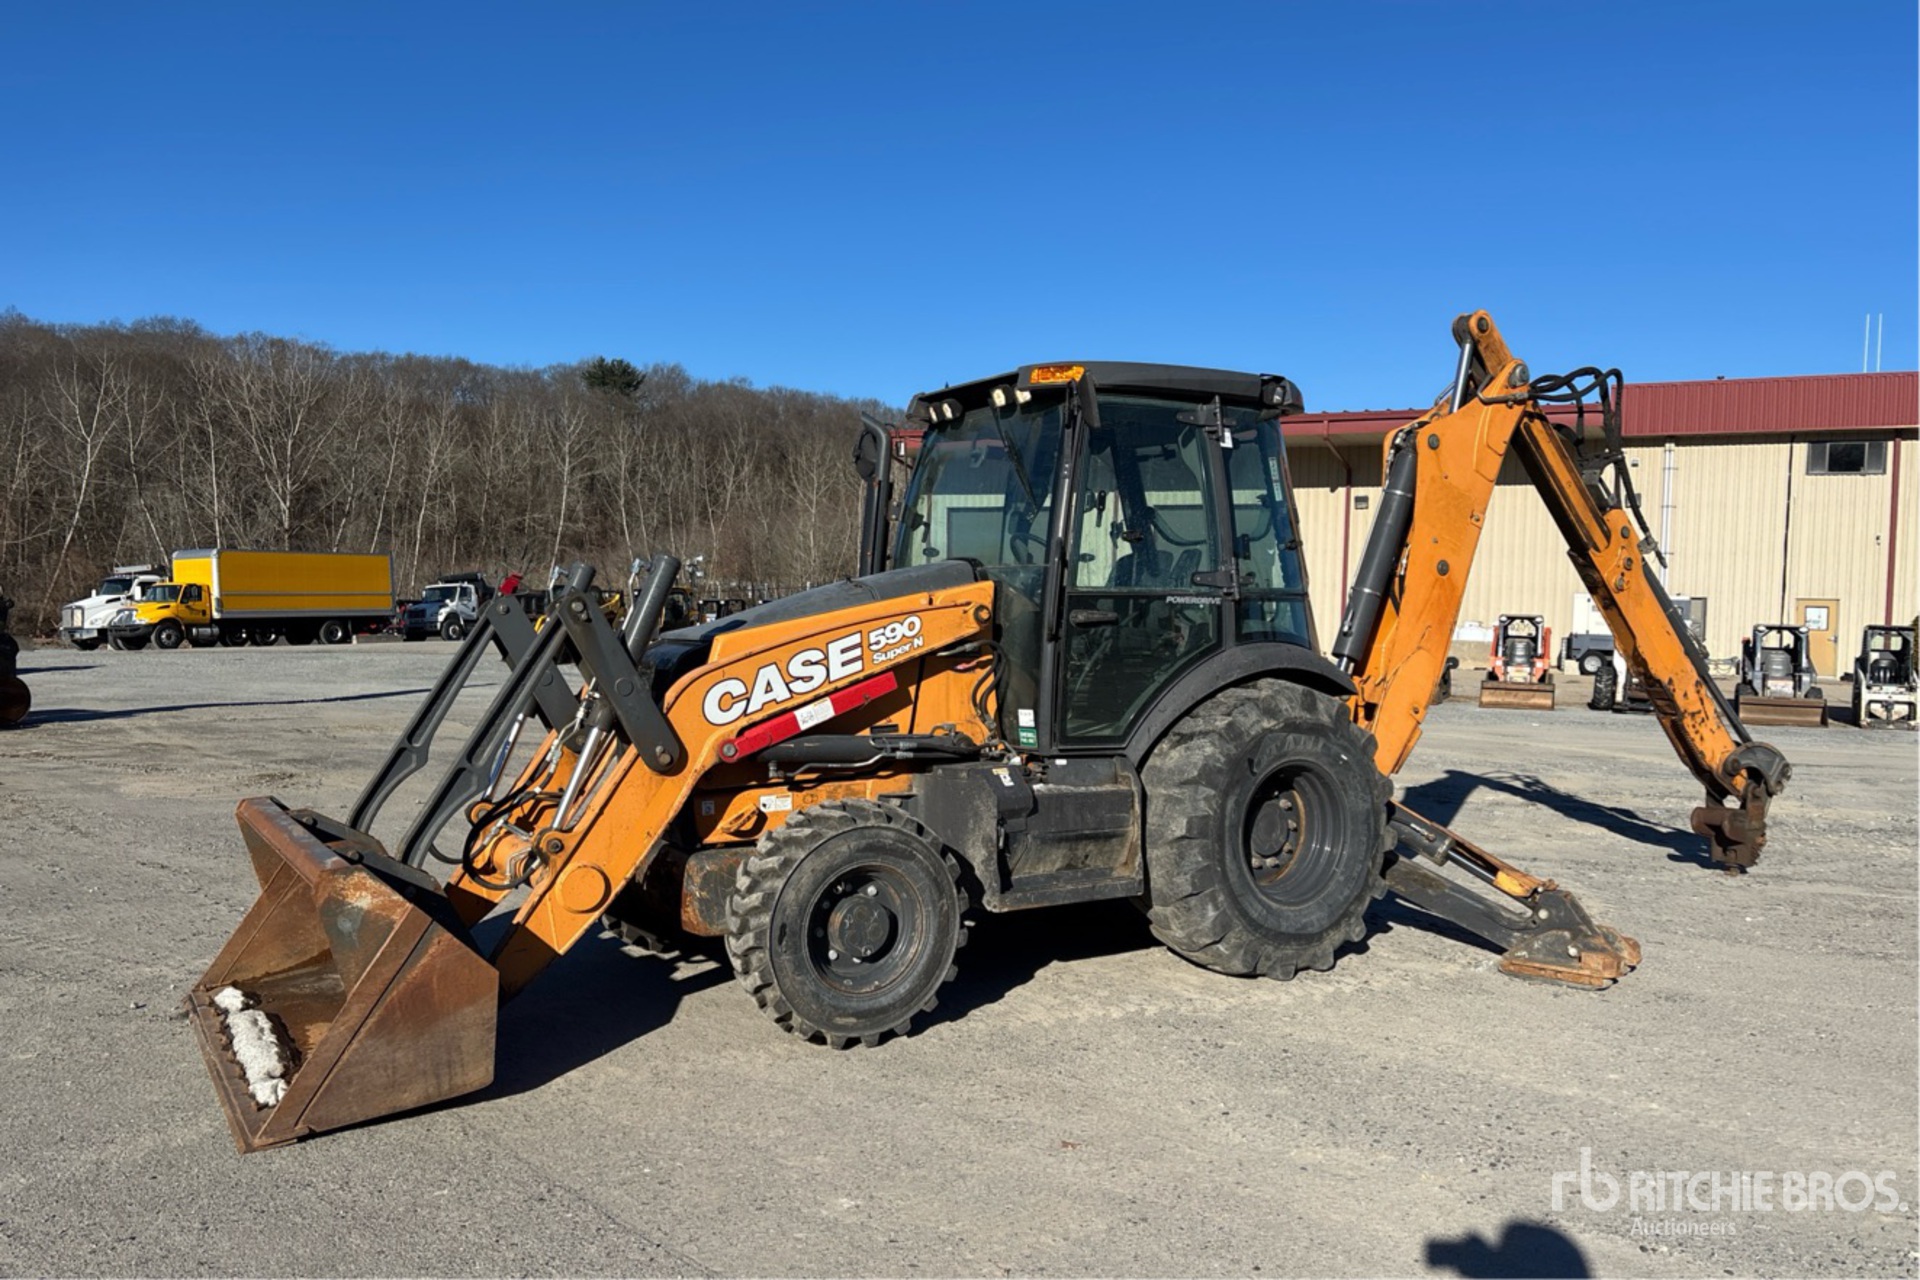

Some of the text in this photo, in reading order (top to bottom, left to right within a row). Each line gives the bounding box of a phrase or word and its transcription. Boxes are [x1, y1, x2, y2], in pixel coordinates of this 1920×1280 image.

[1165, 595, 1222, 605] POWERDRIVE
[868, 615, 922, 651] 590
[872, 635, 924, 664] Super N
[702, 631, 865, 727] CASE
